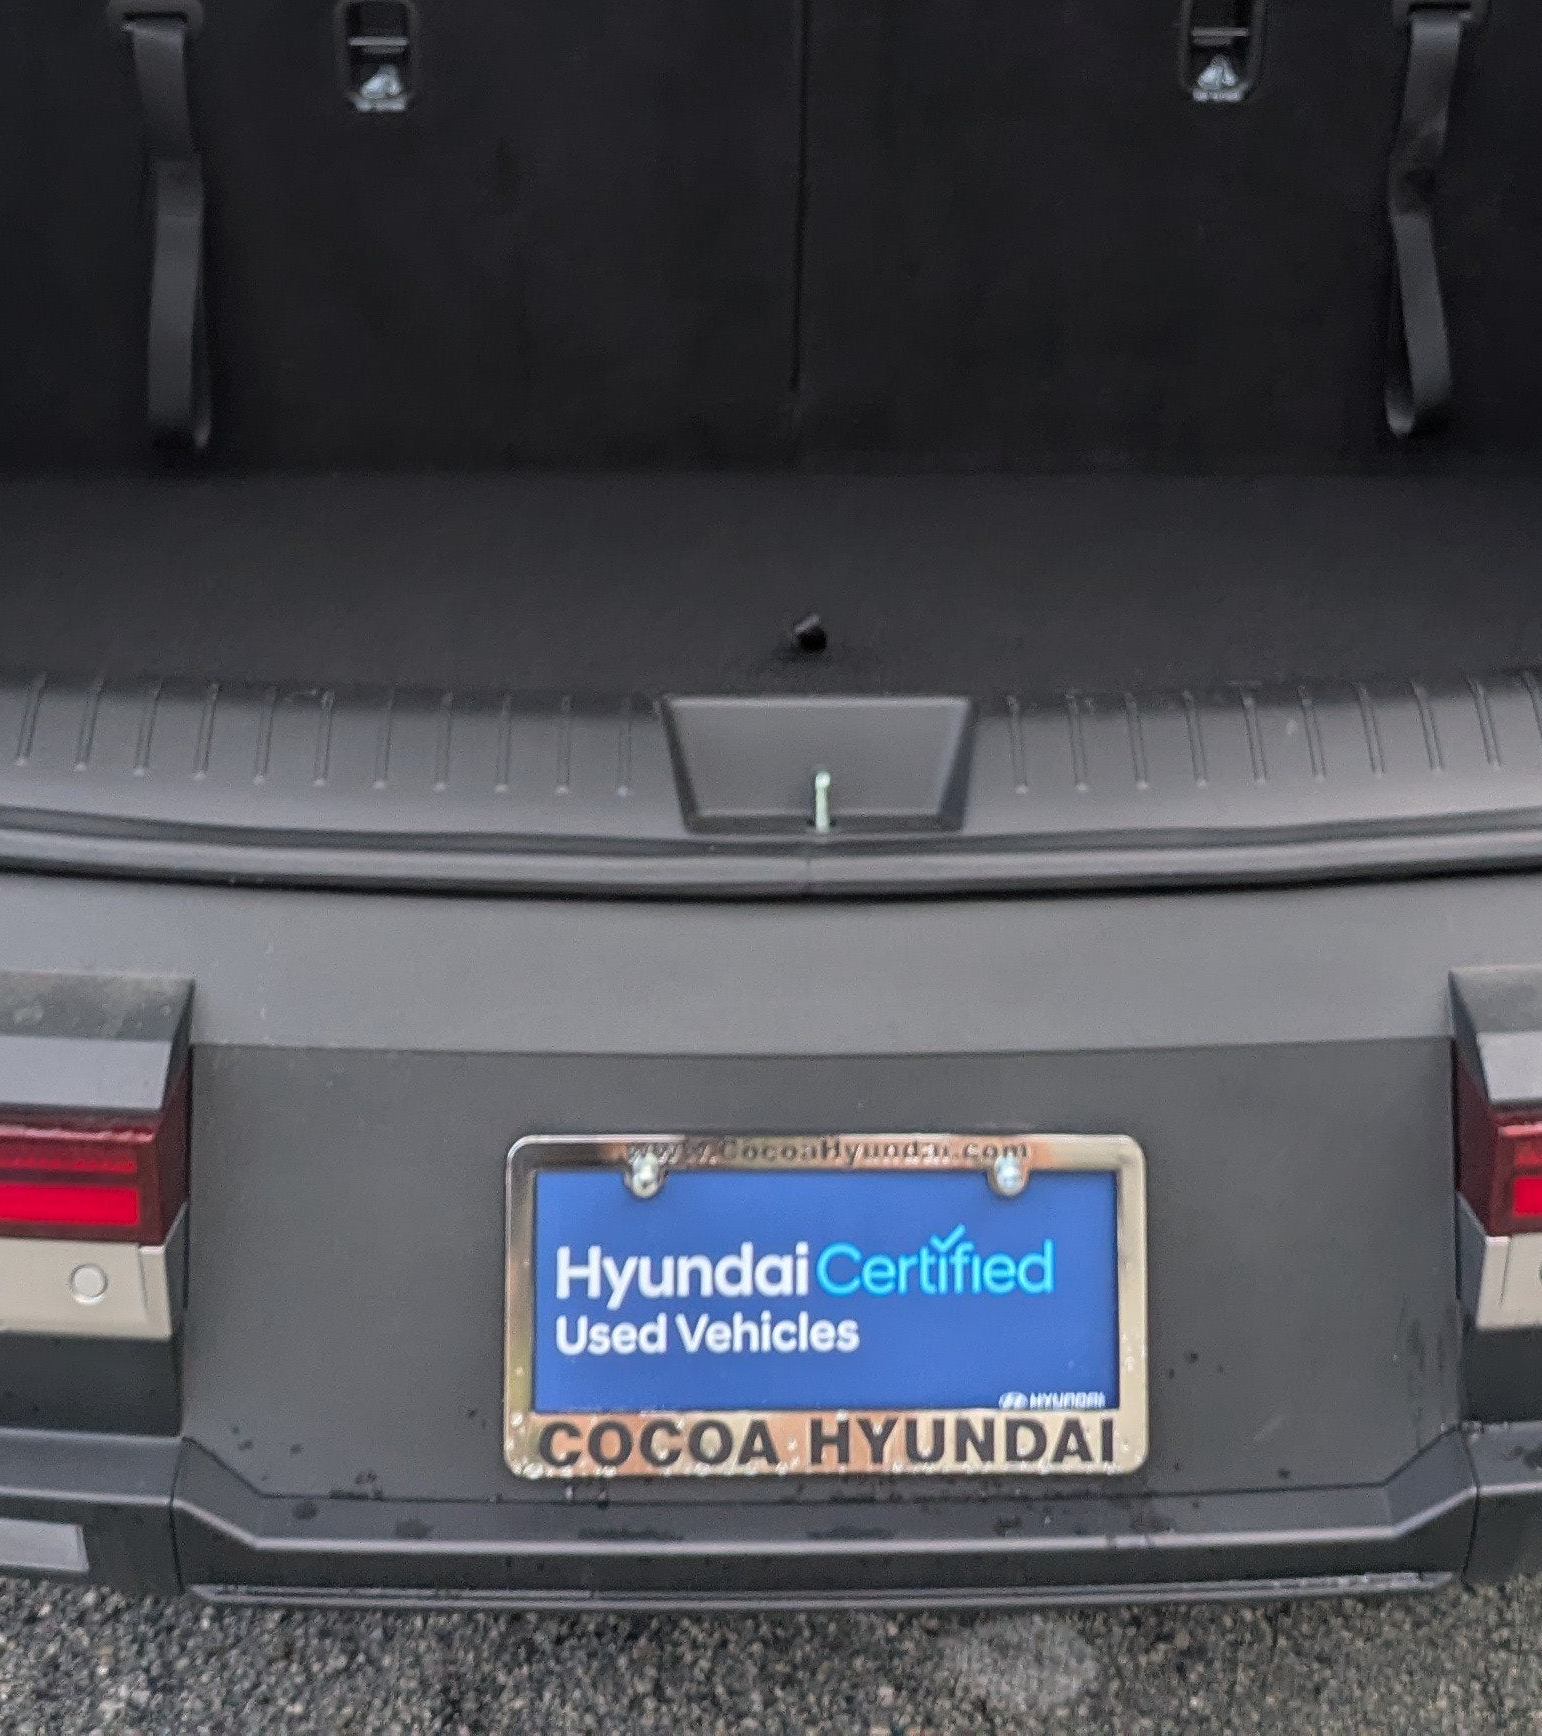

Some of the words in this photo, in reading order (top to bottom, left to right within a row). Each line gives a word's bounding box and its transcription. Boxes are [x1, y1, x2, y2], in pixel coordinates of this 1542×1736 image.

[556, 1241, 810, 1311] Hyundai
[815, 1224, 1055, 1298] Certified
[555, 1312, 668, 1355] Used
[675, 1310, 860, 1353] Vehicles
[538, 1421, 778, 1465] COCOA
[811, 1419, 1115, 1464] HYUNDAI
